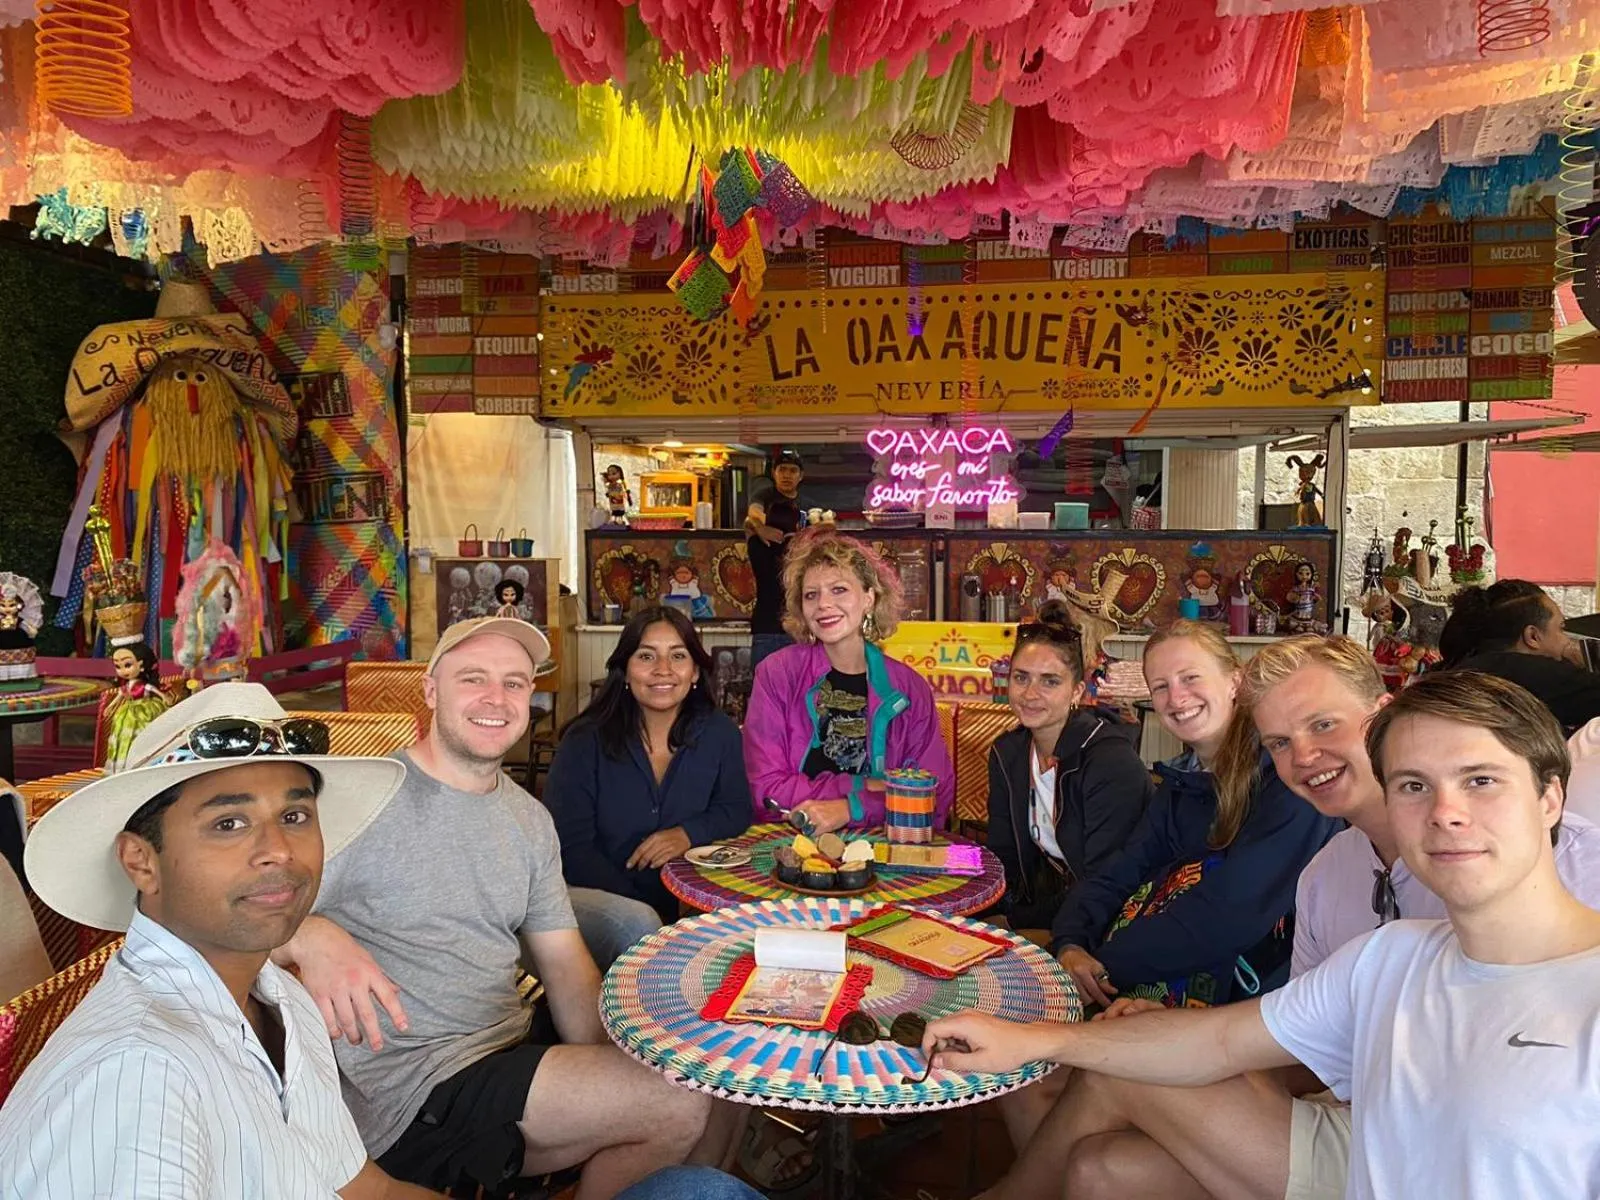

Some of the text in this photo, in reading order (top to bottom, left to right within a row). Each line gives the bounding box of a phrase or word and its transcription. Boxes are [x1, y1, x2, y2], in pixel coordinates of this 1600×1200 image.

[1295, 228, 1369, 249] EXOTICAS
[1336, 253, 1366, 266] OREO
[1490, 245, 1541, 260] MEZCAL
[829, 265, 900, 287] YOGURT
[1053, 258, 1128, 279] YOGURT
[475, 337, 537, 356] TEQUILA
[765, 306, 1122, 381] LA OAXAQUEÑA
[1471, 333, 1551, 356] COCO
[73, 362, 126, 396] La
[1387, 360, 1424, 380] YOGURT
[1425, 360, 1438, 379] DE
[1439, 358, 1468, 379] FRESA
[476, 398, 535, 414] SORBETE
[891, 460, 942, 478] eres
[870, 472, 1017, 508] sabor favorito
[939, 646, 971, 664] LA
